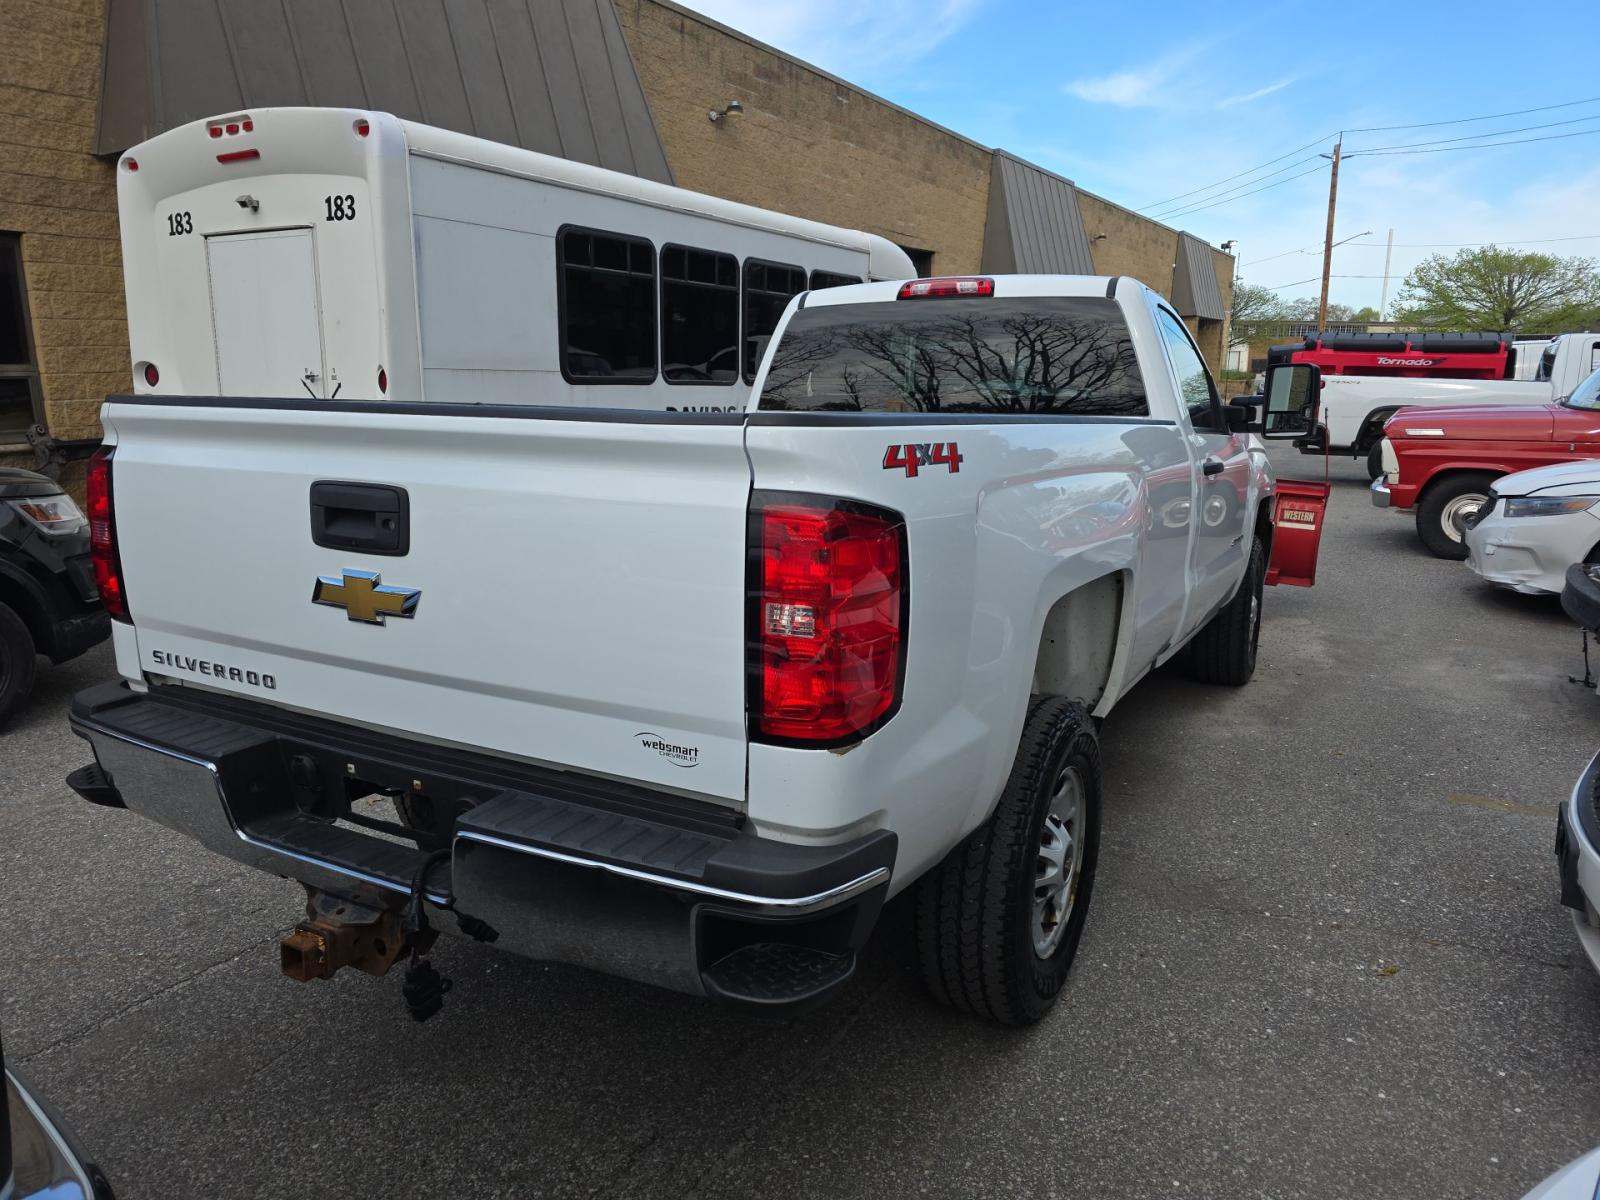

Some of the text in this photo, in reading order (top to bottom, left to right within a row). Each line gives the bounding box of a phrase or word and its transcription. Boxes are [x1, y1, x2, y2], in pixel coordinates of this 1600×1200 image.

[325, 194, 356, 221] 183
[168, 211, 193, 236] 183
[1377, 356, 1433, 366] Tornado
[1283, 510, 1315, 522] WESTERN
[152, 649, 277, 690] SILVERADO
[642, 739, 700, 757] websmart
[659, 751, 697, 763] CHEVROLET
